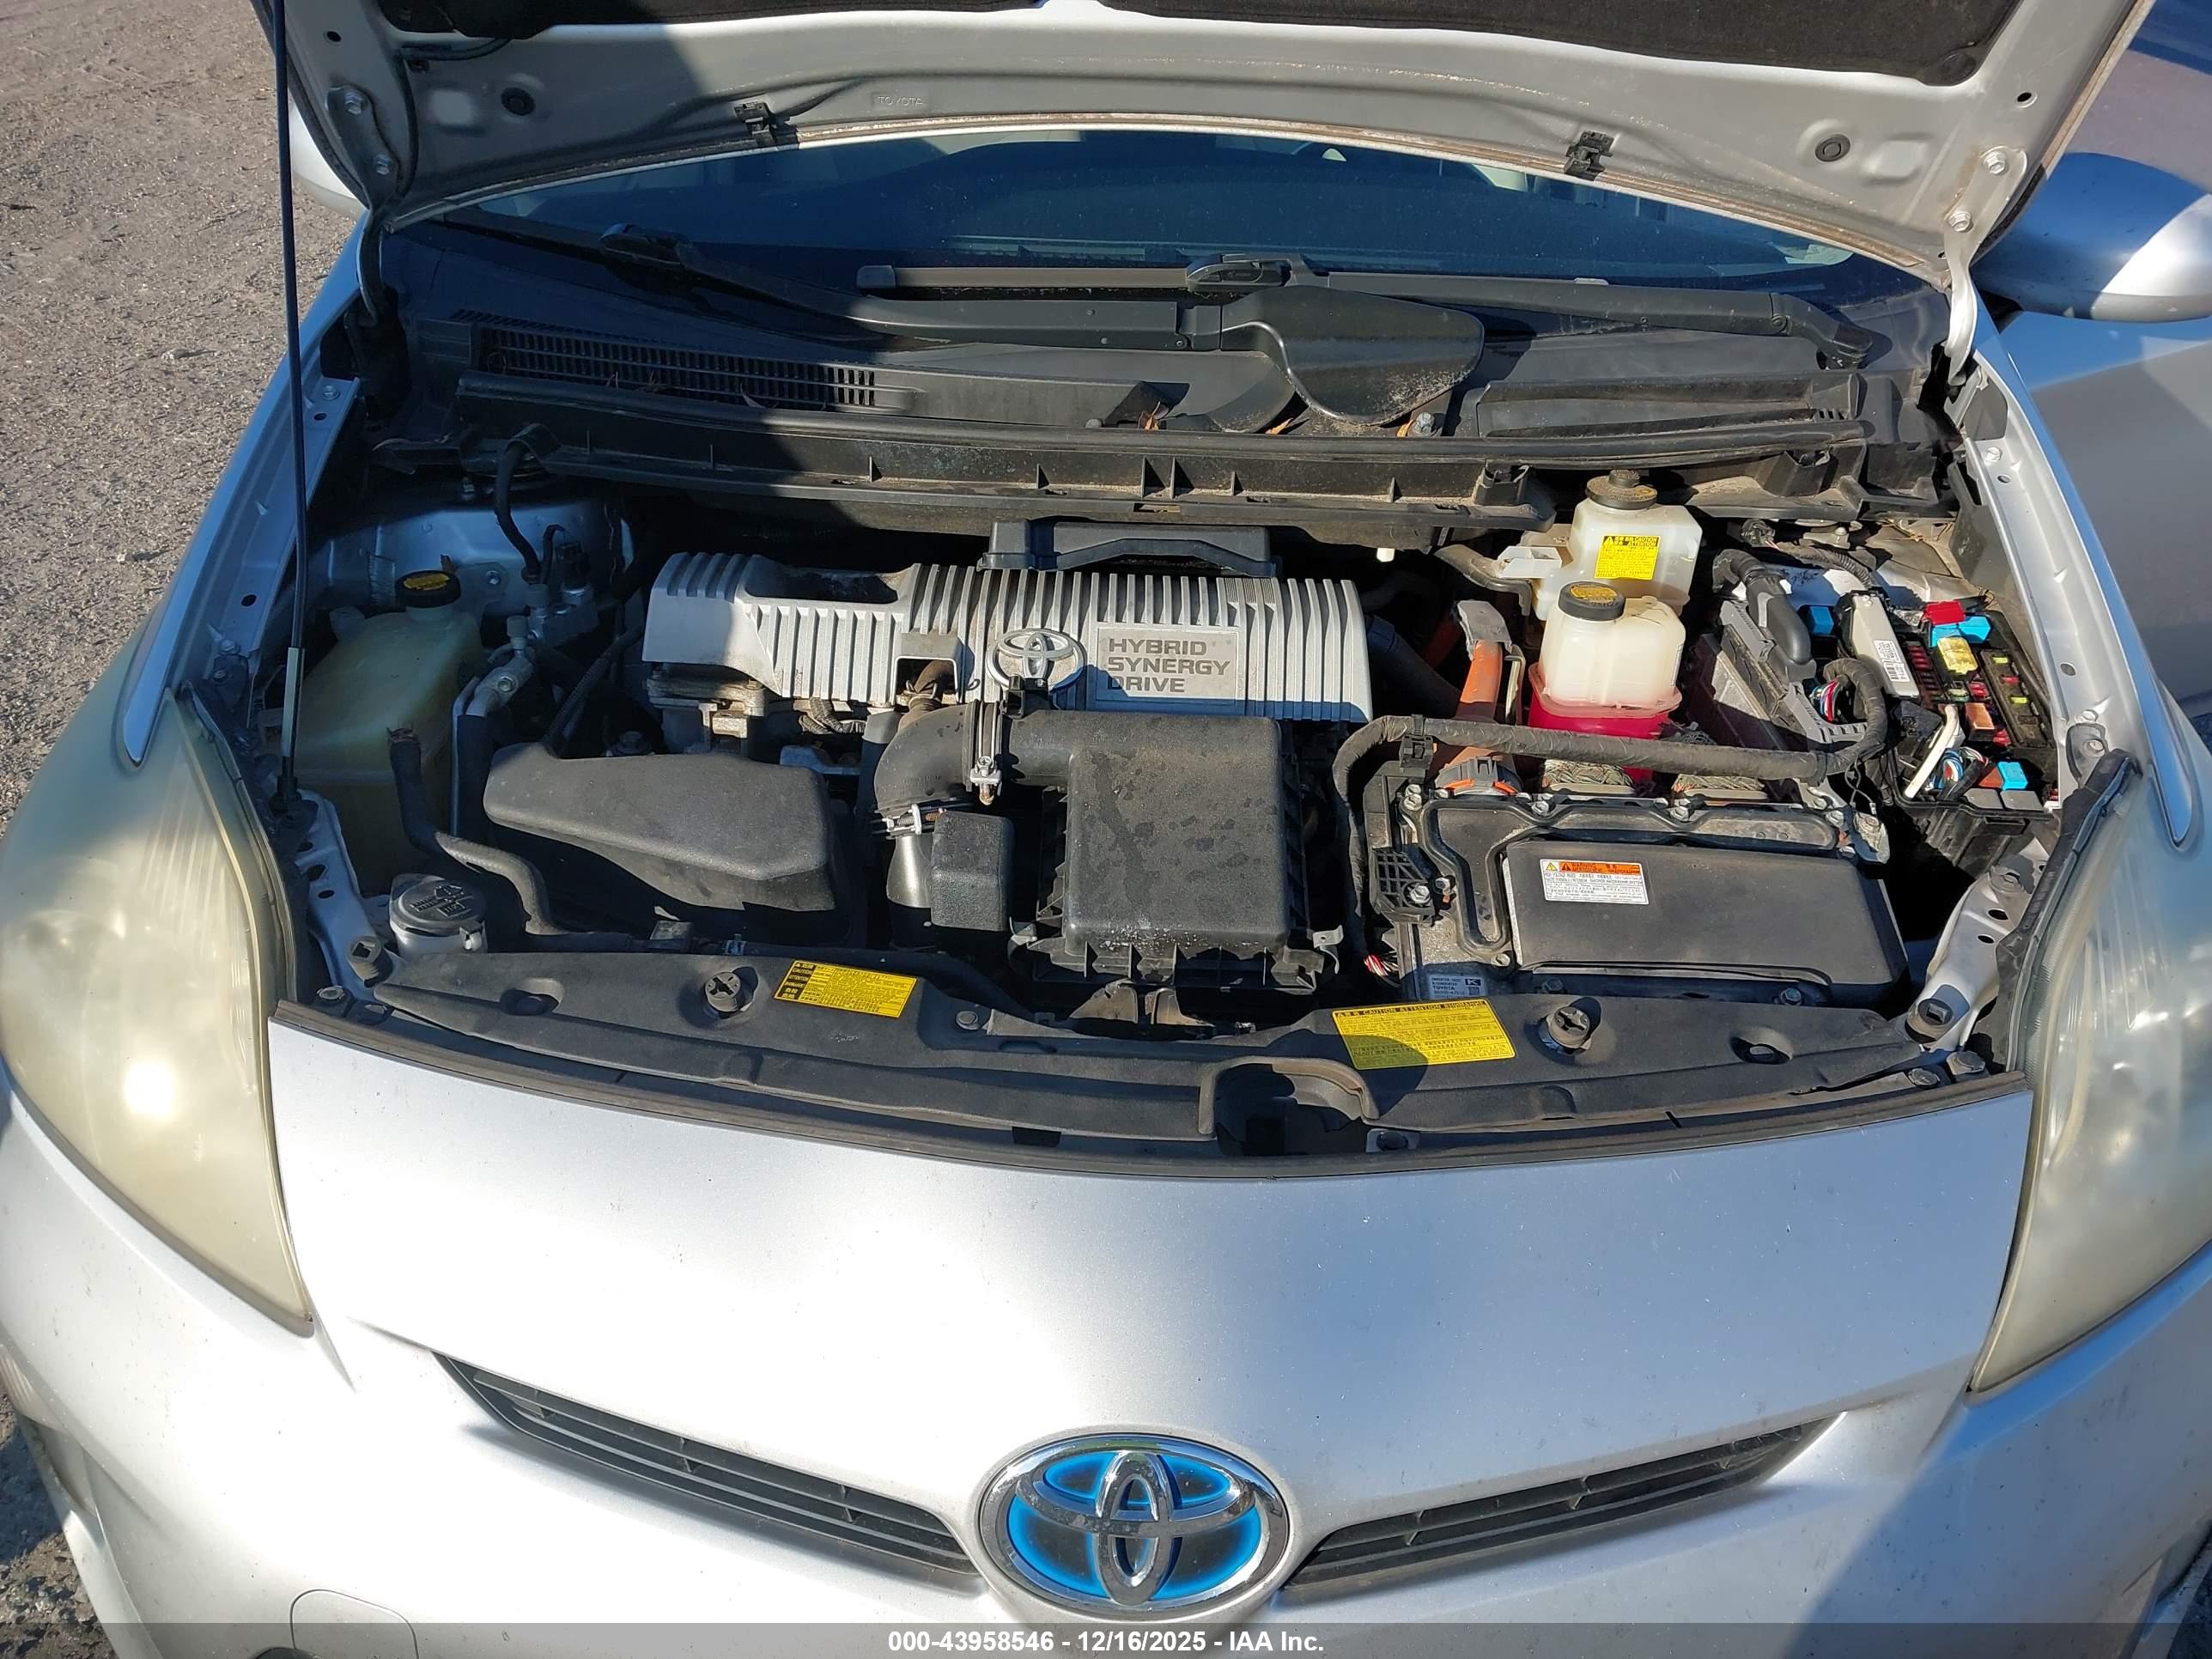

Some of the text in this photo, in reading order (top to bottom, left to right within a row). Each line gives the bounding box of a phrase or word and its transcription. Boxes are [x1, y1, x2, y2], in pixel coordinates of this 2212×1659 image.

[878, 96, 923, 106] TOYOTA
[1109, 638, 1206, 655] HYBRID
[1108, 657, 1230, 675] SYNERGY
[1108, 675, 1185, 692] DRIVE
[1401, 1004, 1442, 1012] ATTENTION
